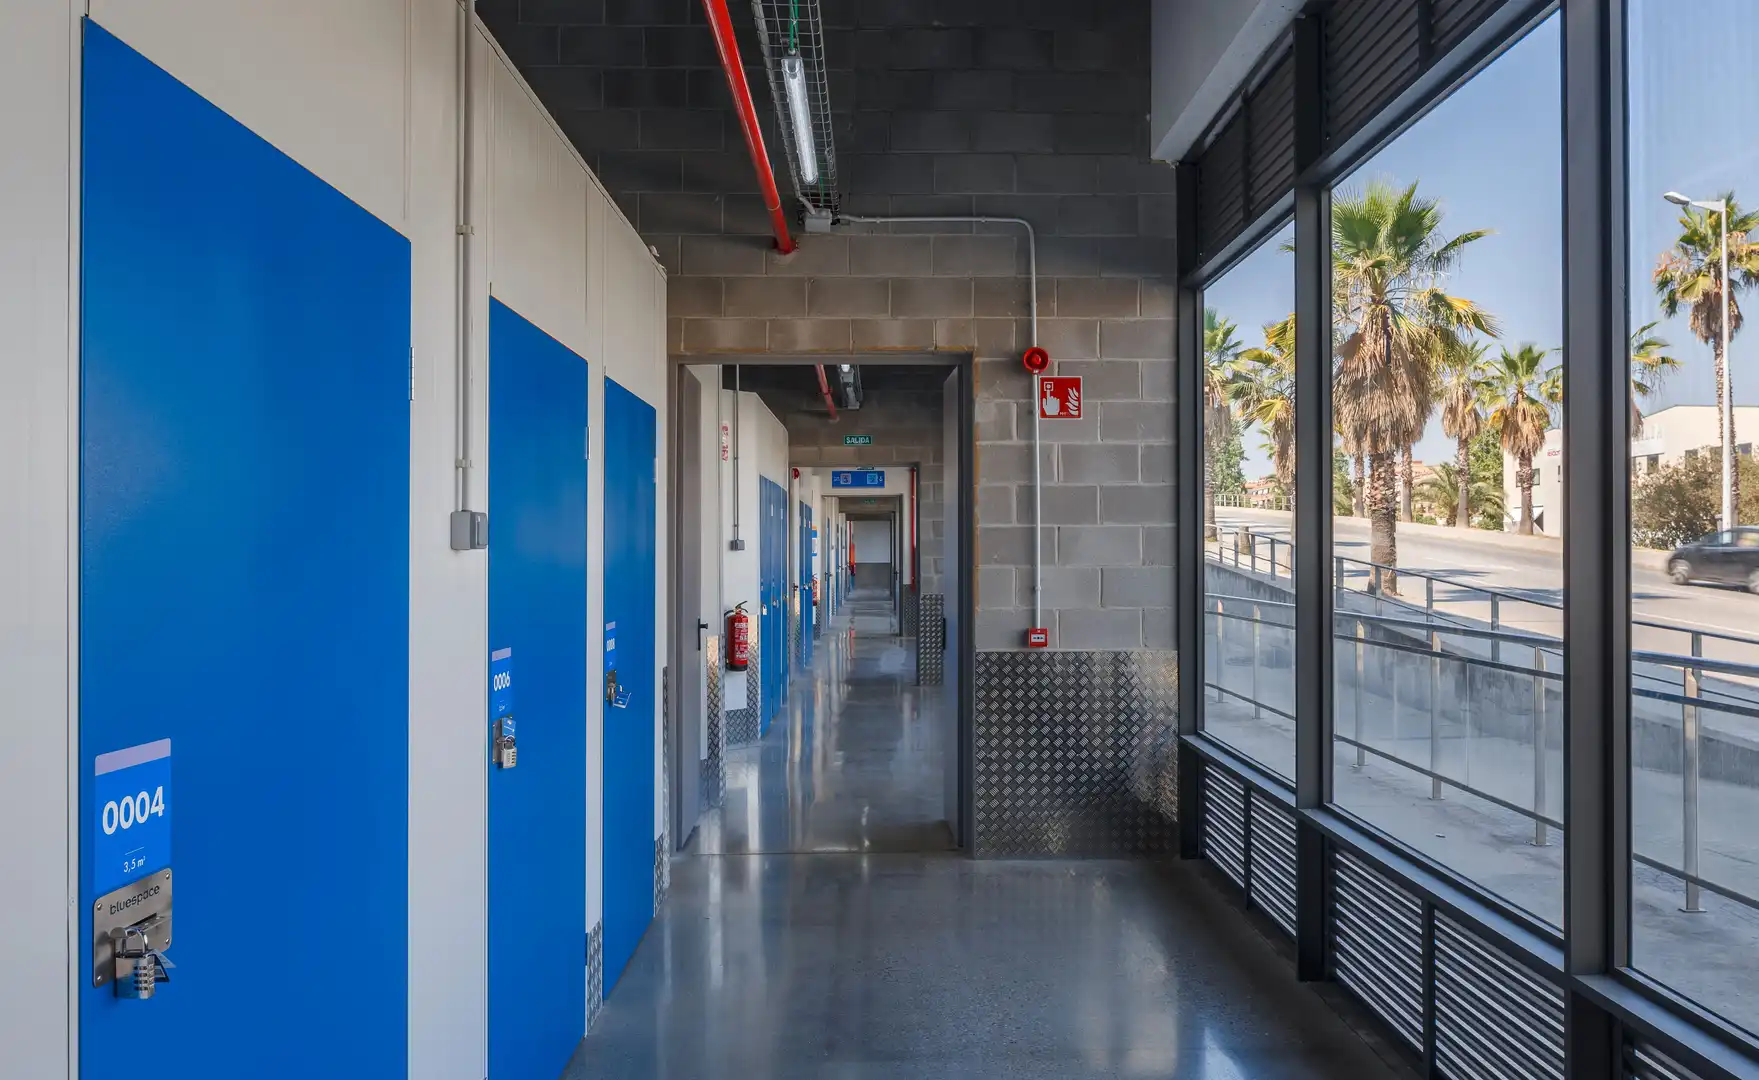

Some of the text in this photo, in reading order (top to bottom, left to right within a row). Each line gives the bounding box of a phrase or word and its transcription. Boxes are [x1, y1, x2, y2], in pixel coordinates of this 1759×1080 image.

[846, 436, 870, 444] SALIDA
[493, 670, 511, 691] 0006
[102, 786, 165, 836] 0004
[123, 858, 136, 873] 3,5
[109, 884, 160, 915] bluespace
